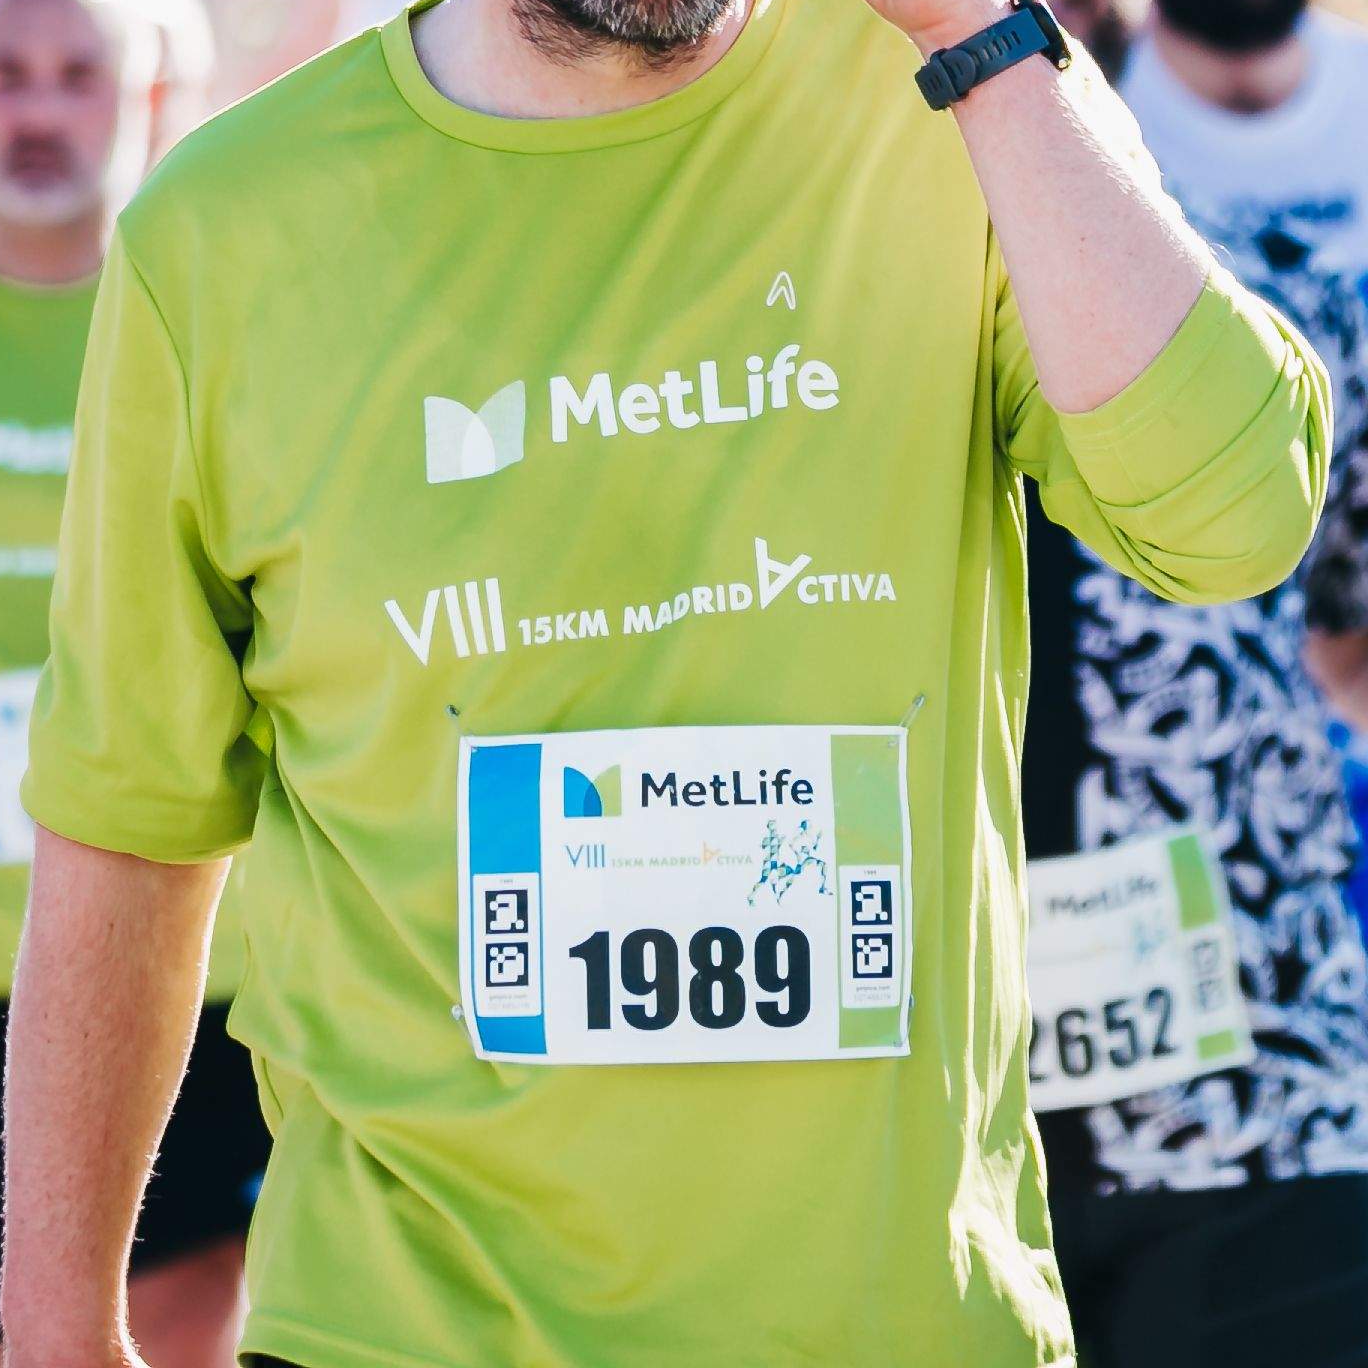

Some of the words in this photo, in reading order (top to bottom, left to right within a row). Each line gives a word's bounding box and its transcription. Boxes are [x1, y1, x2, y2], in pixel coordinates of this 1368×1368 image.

[549, 343, 841, 443] MetLife
[384, 577, 507, 667] VIII
[517, 608, 611, 646] 15KM
[640, 768, 815, 808] MetLife
[565, 843, 606, 869] VIII
[568, 925, 812, 1031] 1989
